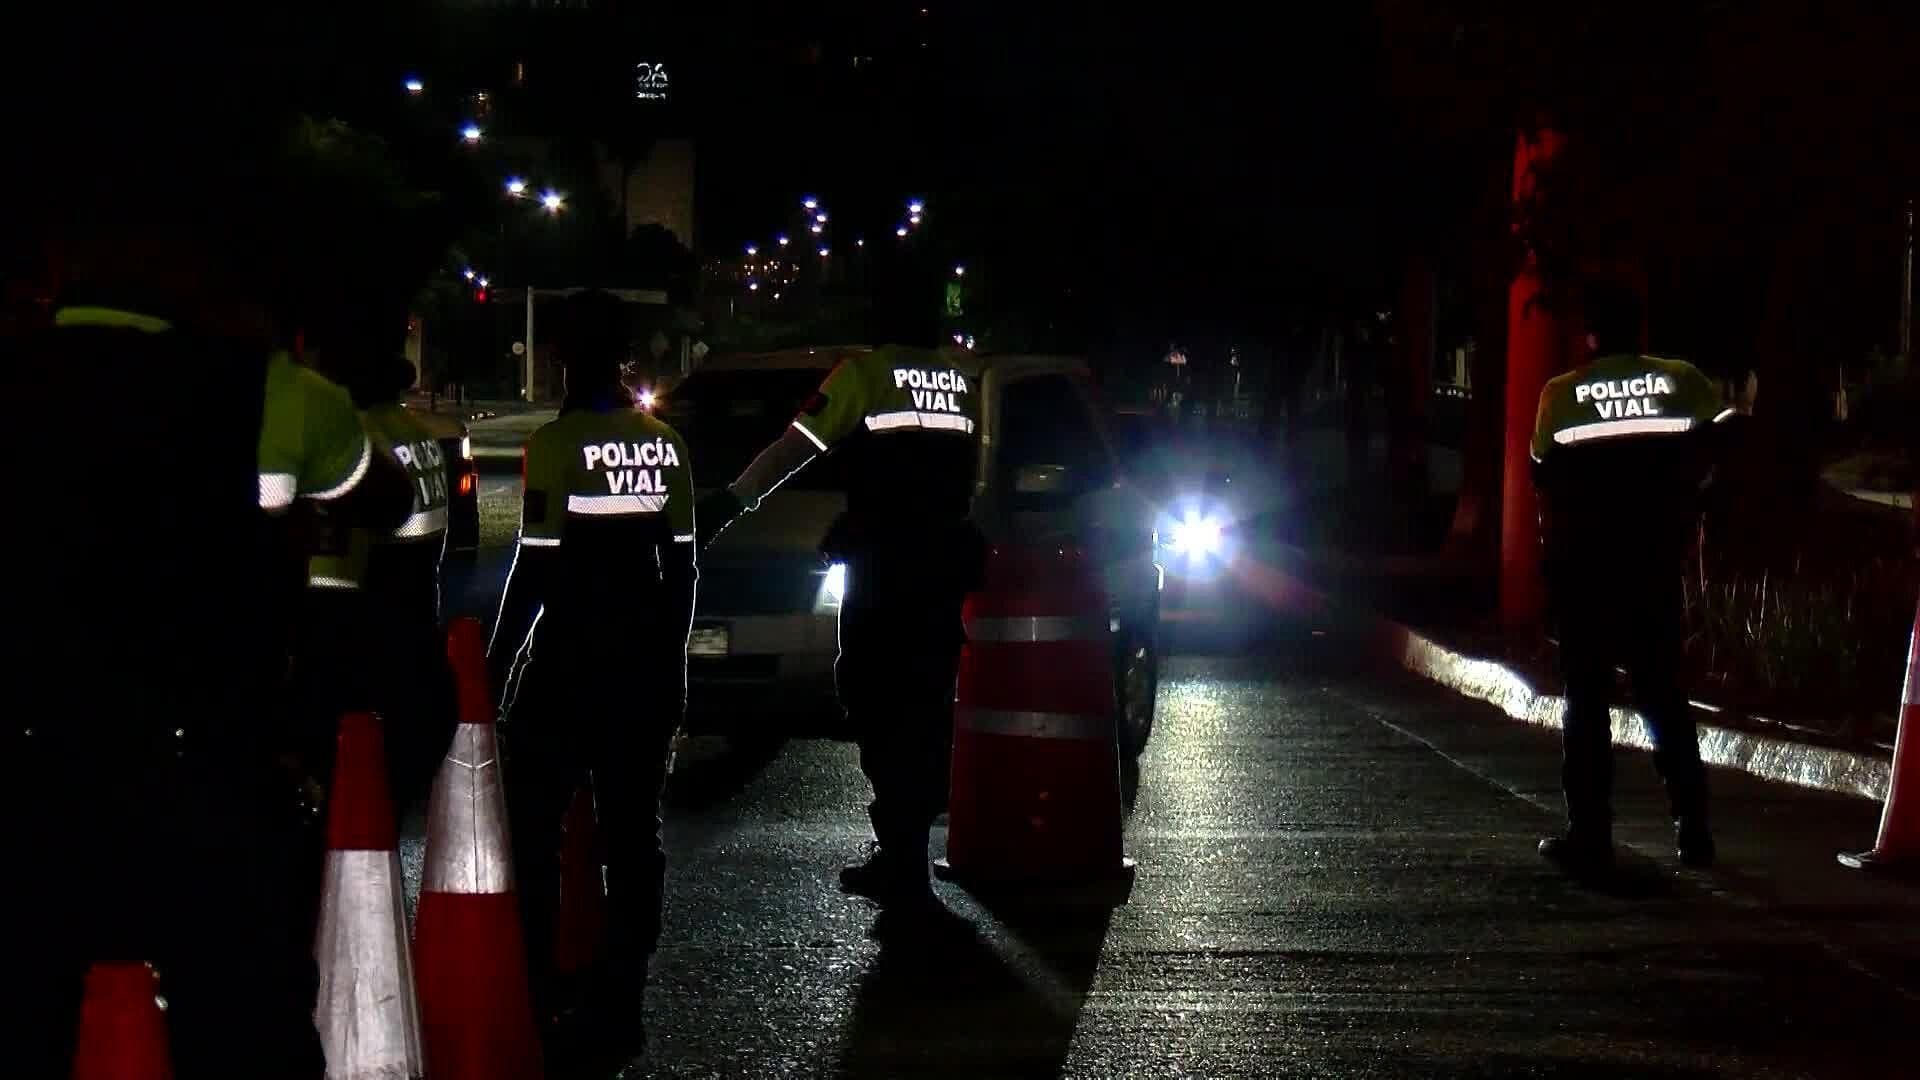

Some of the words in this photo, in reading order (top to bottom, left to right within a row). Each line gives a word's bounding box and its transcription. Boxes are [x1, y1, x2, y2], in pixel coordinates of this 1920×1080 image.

[893, 369, 968, 394] POLICÍA
[1575, 373, 1671, 403] POLICÍA
[911, 390, 960, 412] VIAL
[1595, 398, 1658, 419] VIAL
[583, 437, 680, 470] POLICÍA
[606, 469, 667, 494] VIAL
